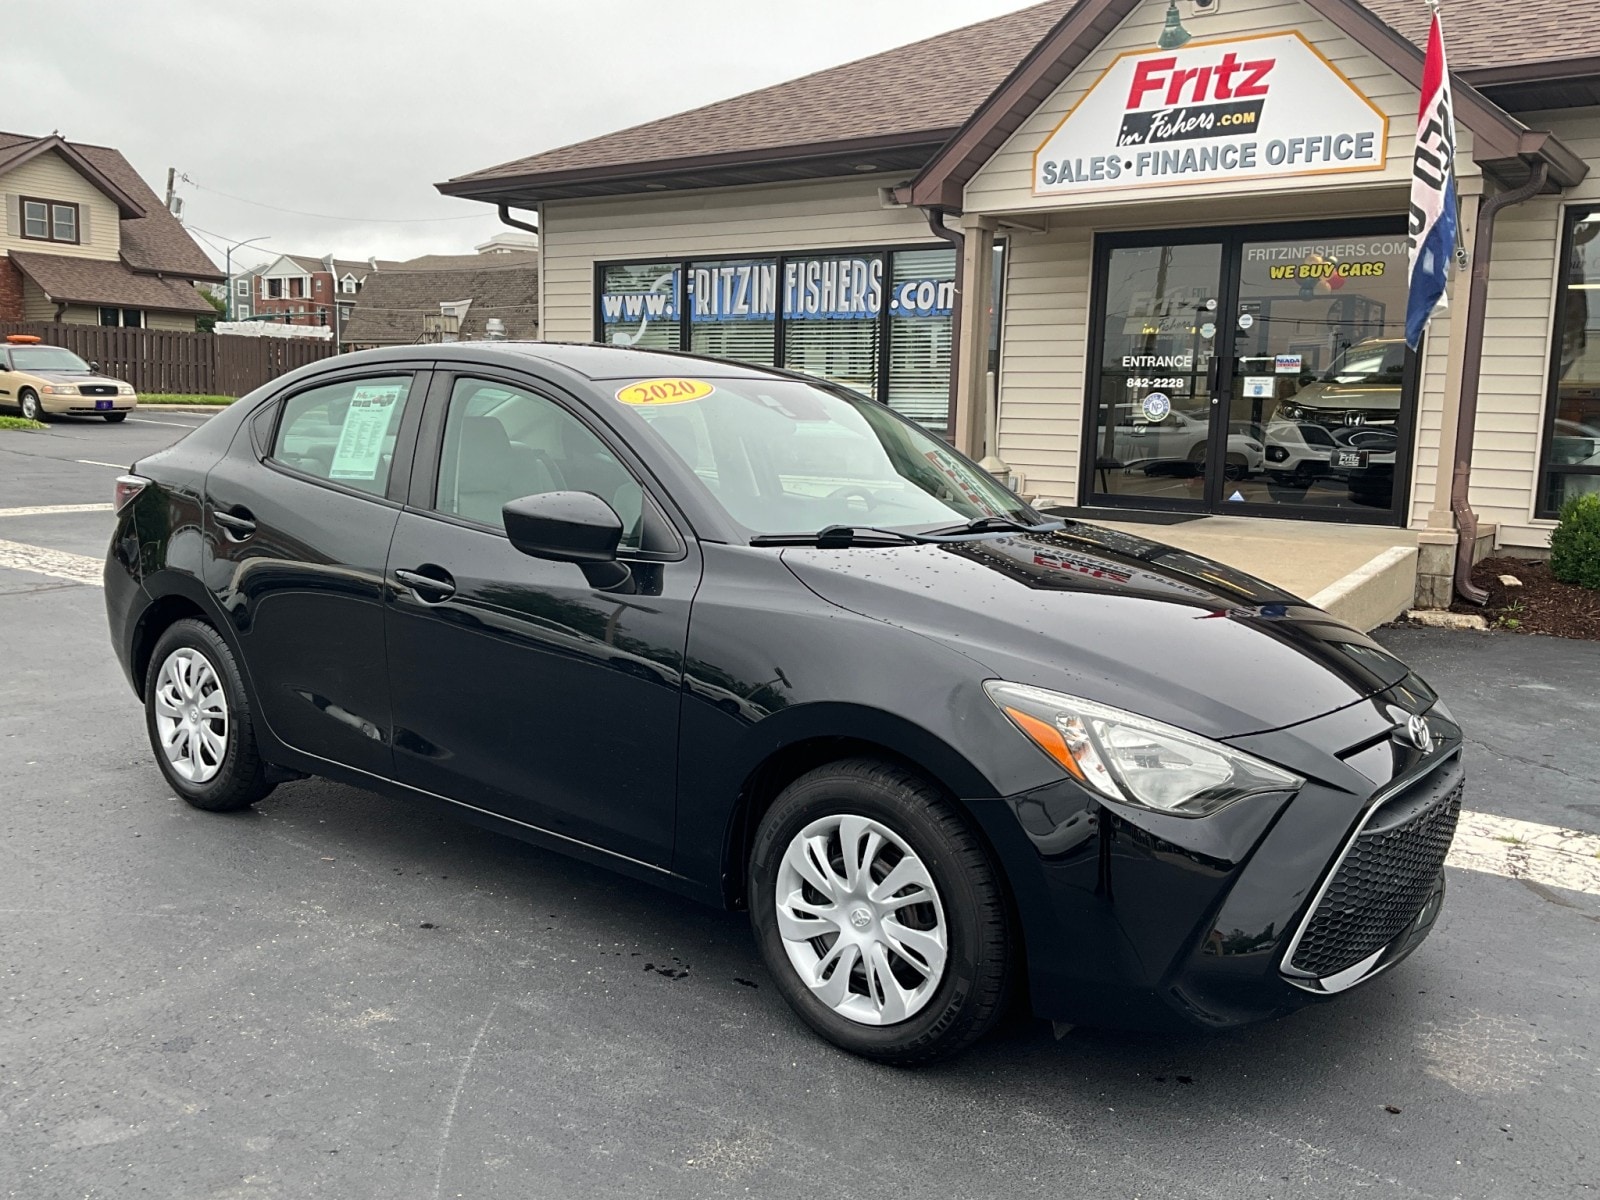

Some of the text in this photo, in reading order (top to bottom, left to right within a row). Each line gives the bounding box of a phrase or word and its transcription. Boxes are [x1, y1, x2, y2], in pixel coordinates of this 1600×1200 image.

[1126, 53, 1276, 110] Fritz
[1118, 126, 1144, 147] in
[1144, 108, 1217, 144] Fishers
[1042, 131, 1375, 185] SALES FINANCE OFFICE
[1247, 242, 1407, 261] FRITZINFISHERS.COM
[1270, 261, 1385, 280] WE BUY CARS
[1122, 355, 1193, 367] ENTRANCE
[633, 381, 696, 403] 2020
[1126, 378, 1184, 388] 842-2228
